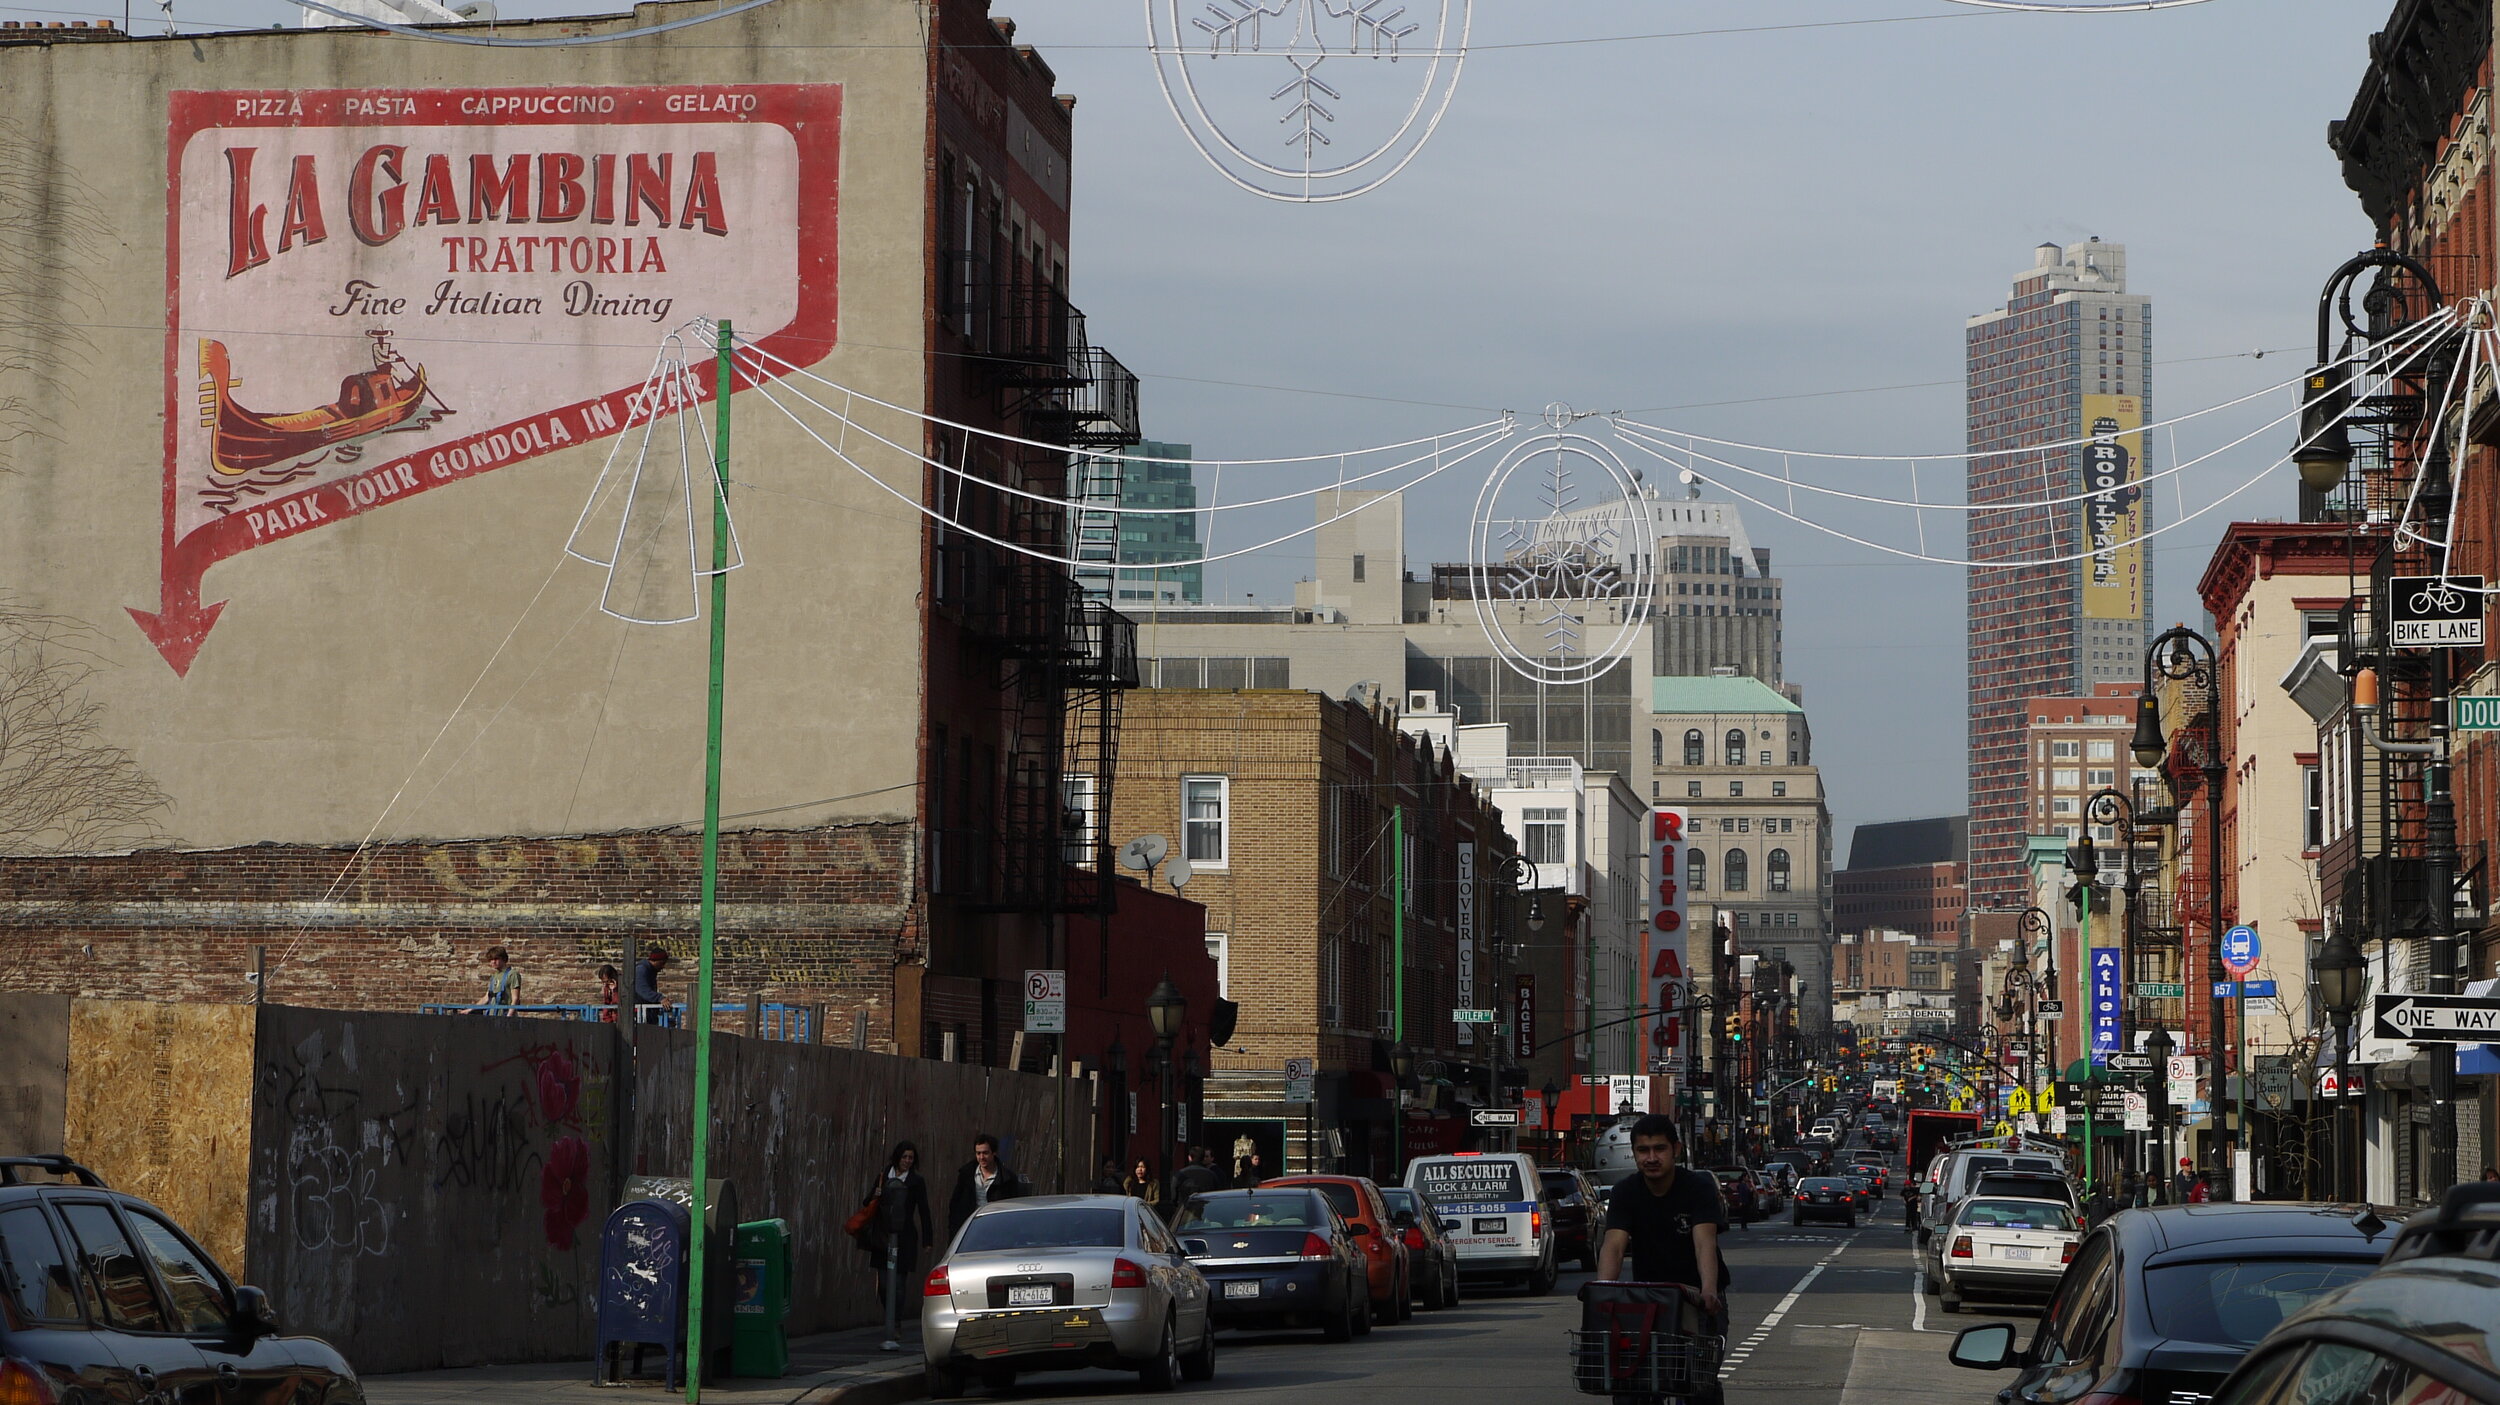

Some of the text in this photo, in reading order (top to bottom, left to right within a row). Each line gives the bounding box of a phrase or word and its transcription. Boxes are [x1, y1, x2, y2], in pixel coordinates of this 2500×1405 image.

[236, 93, 756, 117] PIZZA PASTA CAPPUCCINO GELATO
[223, 143, 728, 280] LA GAMBINA
[441, 236, 667, 274] TRATTORIA
[329, 279, 673, 323] Fine Italian Dining
[245, 371, 708, 540] PARK YOUR GONDOLA IN REAR
[2397, 622, 2478, 639] BIKE LANE
[2461, 700, 2500, 726] DOU
[1653, 811, 1683, 932] Rite
[1459, 852, 1472, 1008] CLOVER CLUB
[1652, 948, 1683, 1048] Aid
[2097, 953, 2114, 1042] Athena
[2138, 984, 2174, 996] BUTLER
[2213, 983, 2232, 996] B57
[1453, 1011, 1483, 1020] BUTLER
[1520, 987, 1531, 1056] BAGELS
[2396, 1009, 2497, 1029] ONE WAY
[2115, 1058, 2131, 1066] ONE
[1613, 1079, 1646, 1089] ADVACED
[2325, 1076, 2365, 1090] AM
[1423, 1164, 1512, 1180] ALL SECURITY
[1429, 1181, 1507, 1193] LOCK & ALARM
